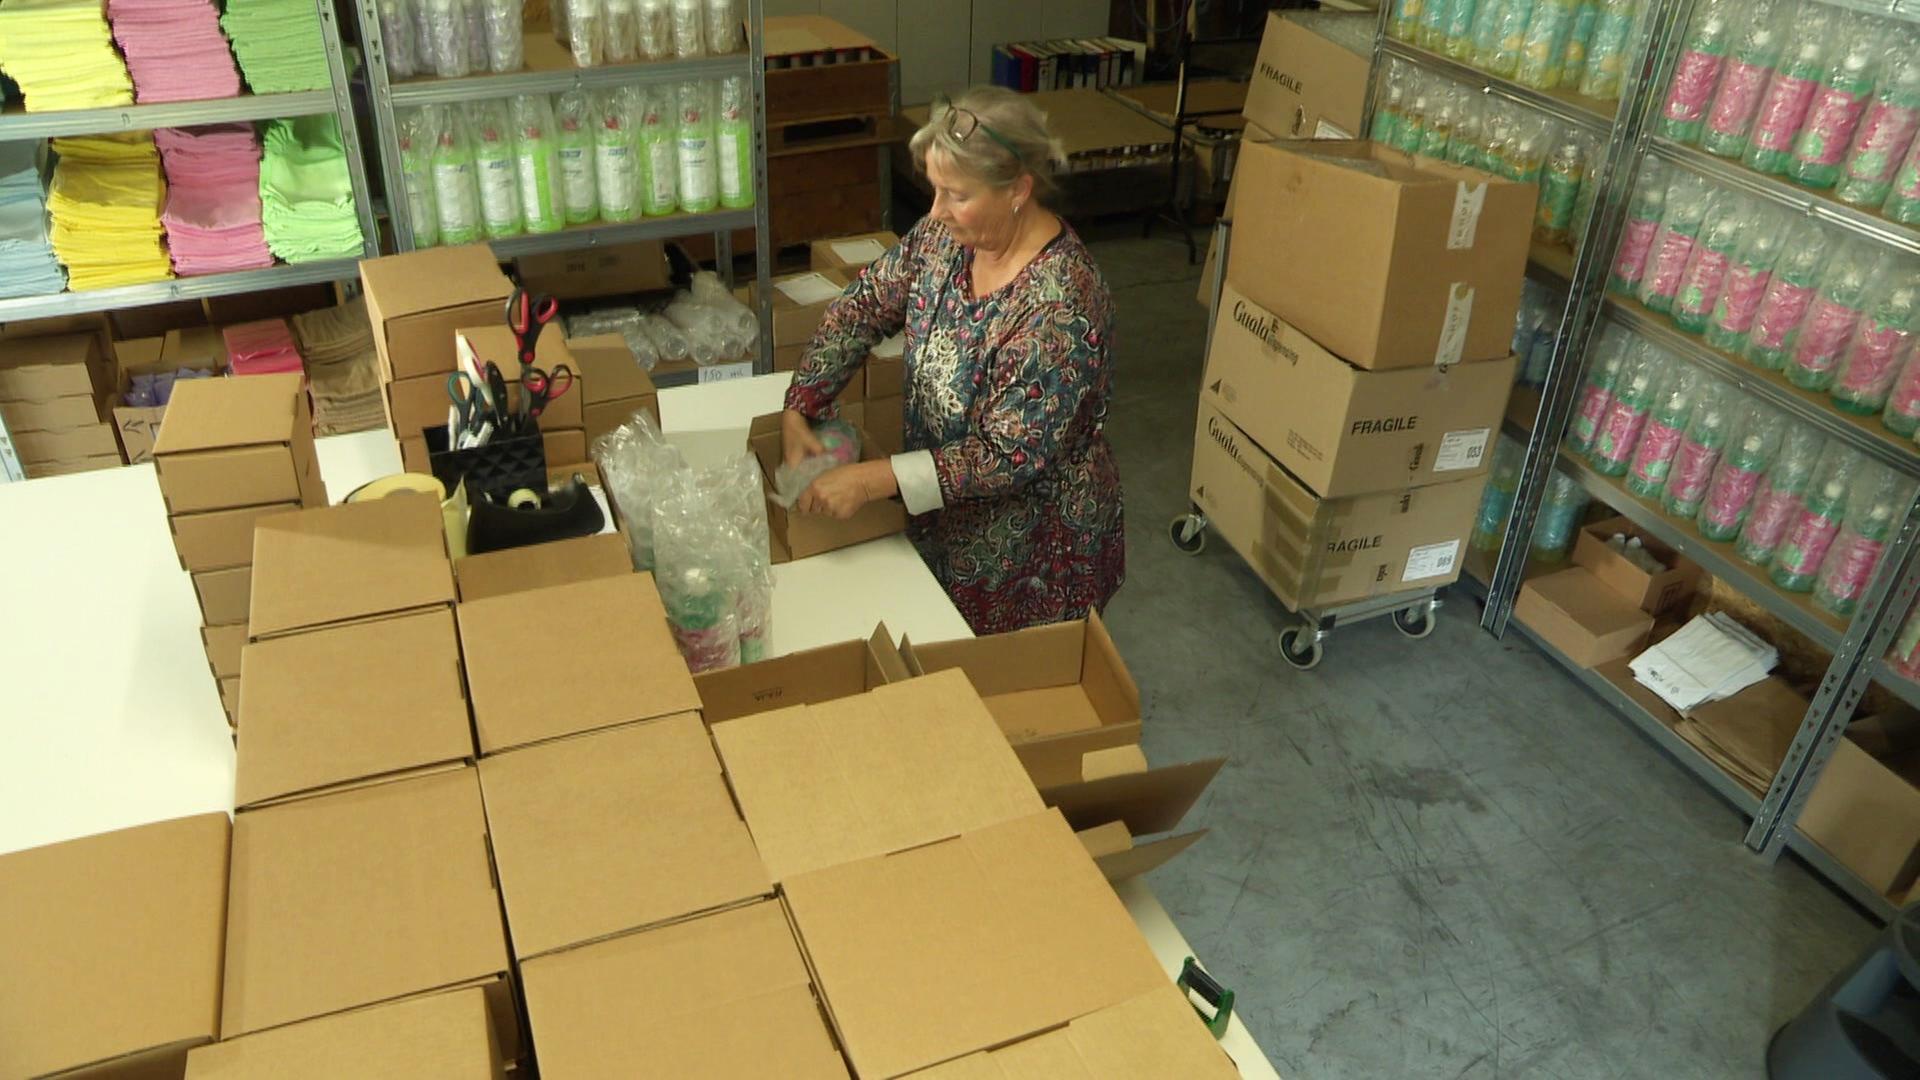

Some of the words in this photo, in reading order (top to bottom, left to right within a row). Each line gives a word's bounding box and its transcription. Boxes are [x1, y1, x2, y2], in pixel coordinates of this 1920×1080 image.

[1260, 62, 1303, 95] FRAGILE
[1233, 300, 1269, 342] Guala
[1208, 416, 1239, 460] Guala
[1351, 415, 1418, 435] FRAGILE
[1327, 535, 1383, 553] RAGILE
